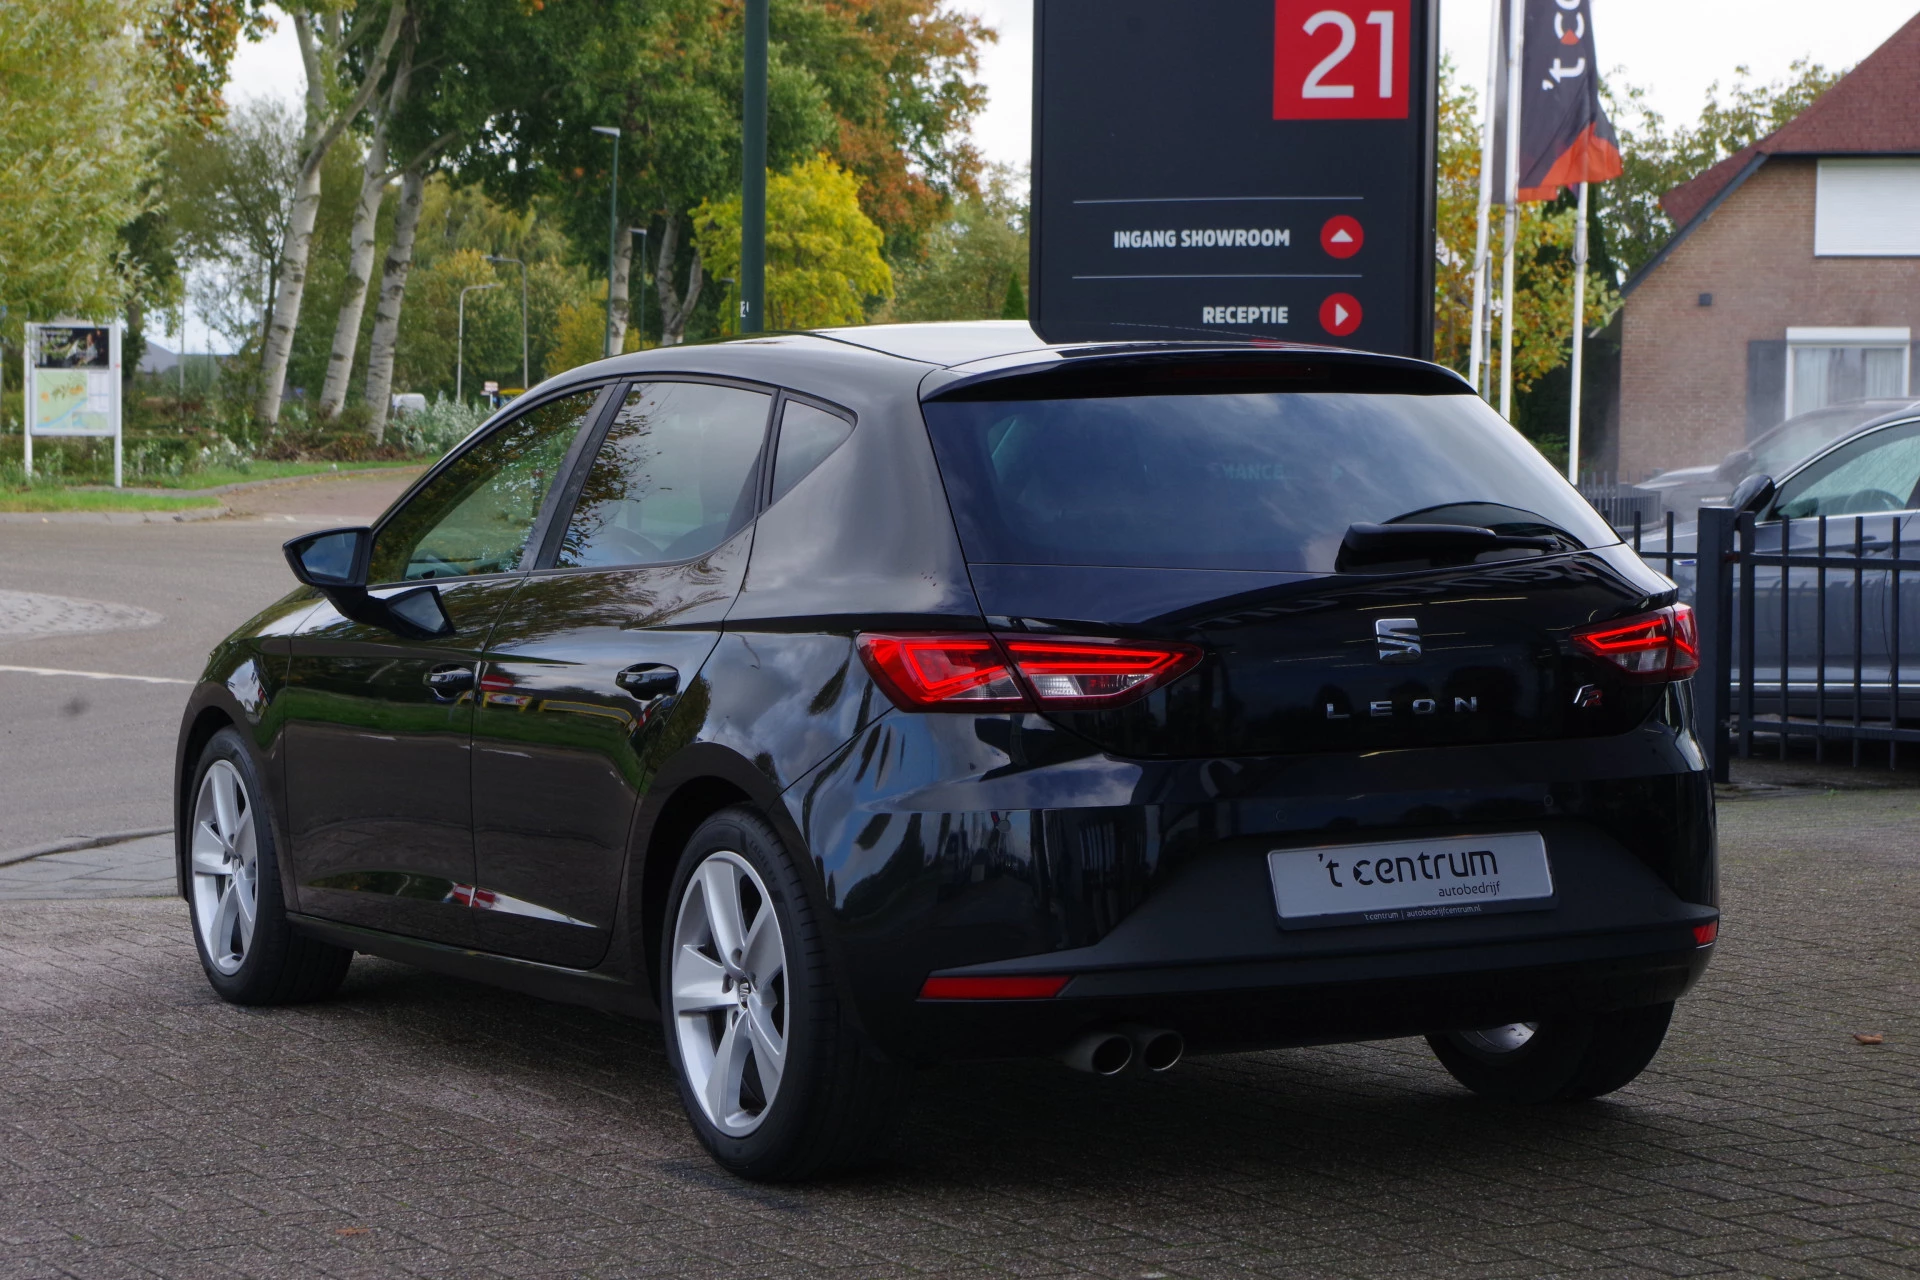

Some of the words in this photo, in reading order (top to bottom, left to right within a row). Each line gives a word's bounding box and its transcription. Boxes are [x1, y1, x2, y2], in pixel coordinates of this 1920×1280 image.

[1301, 9, 1394, 99] 21
[1113, 230, 1177, 248] INGANG
[1180, 229, 1290, 247] SHOWROOM
[1202, 306, 1289, 324] RECEPTIE
[1326, 696, 1478, 719] LEON
[1317, 852, 1343, 888] 't
[1352, 850, 1499, 887] centrum
[1438, 880, 1501, 897] autobedrijf
[1406, 904, 1482, 918] autobedrijfcentrum.nl
